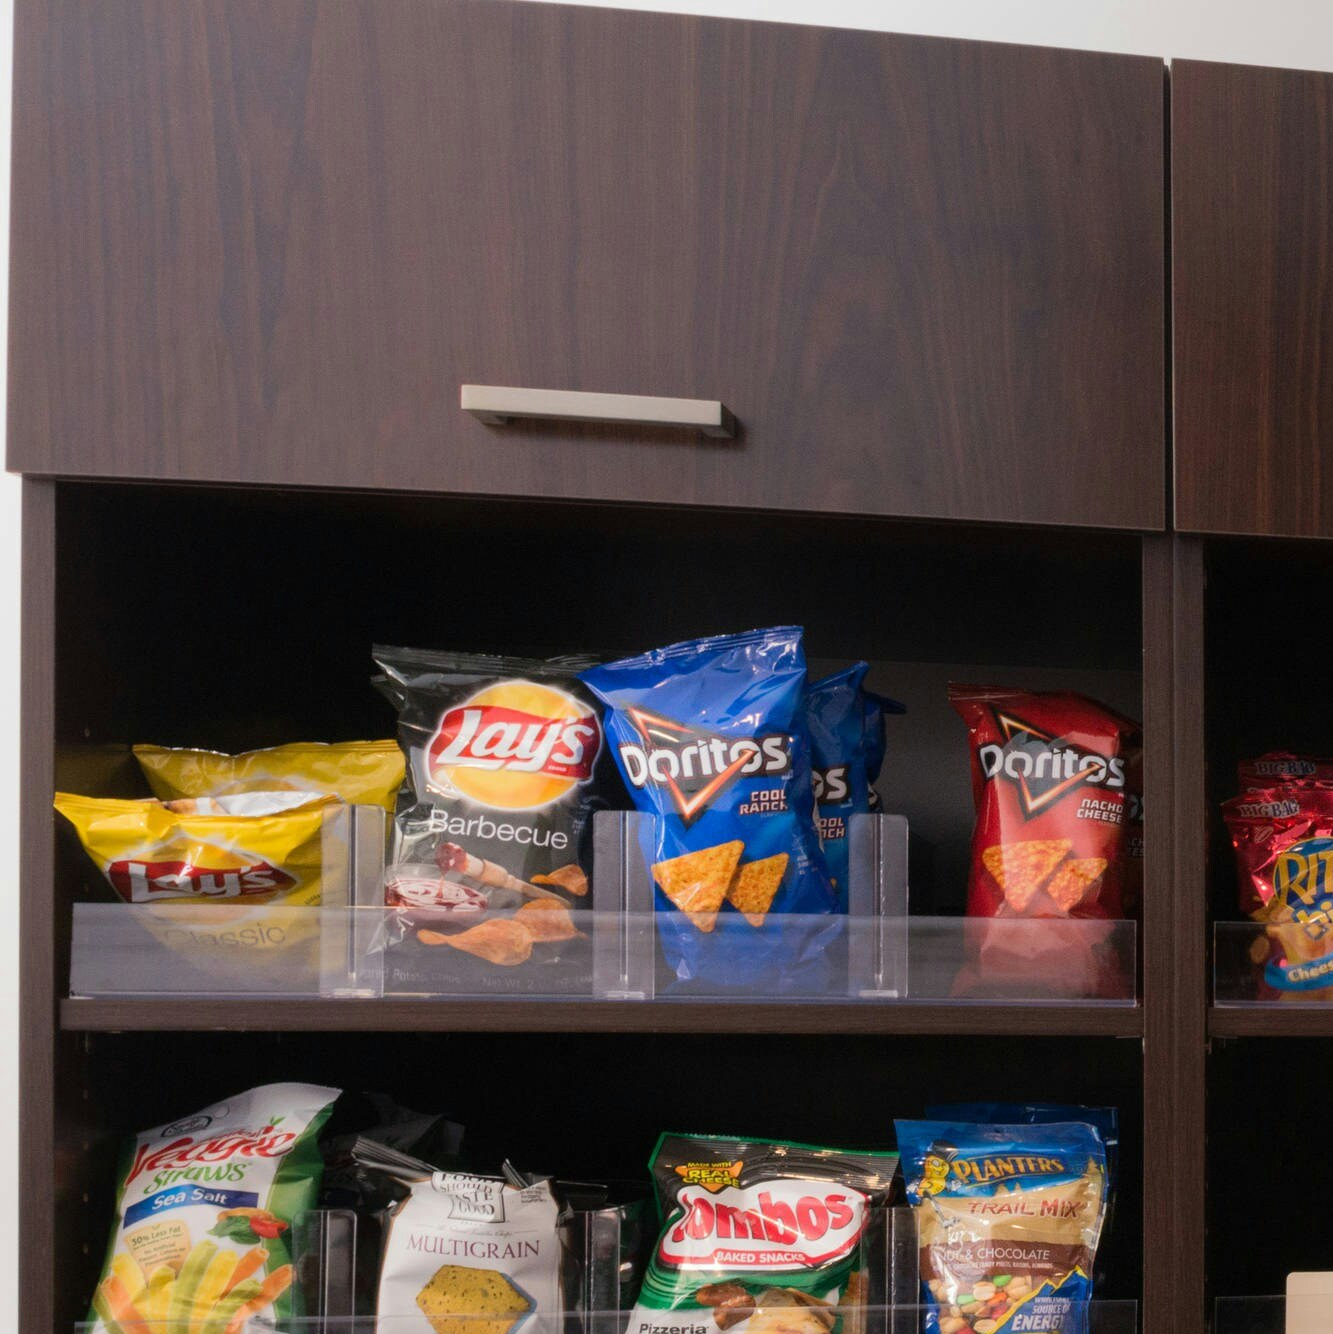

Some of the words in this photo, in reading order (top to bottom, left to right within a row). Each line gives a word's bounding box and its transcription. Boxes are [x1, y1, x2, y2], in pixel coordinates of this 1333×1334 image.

[437, 709, 595, 770] Lay's
[619, 735, 790, 789] Doritos
[980, 744, 1125, 788] Doritos
[750, 789, 787, 803] COOL
[1081, 799, 1124, 814] NACHO
[739, 800, 789, 816] RANCH
[1076, 809, 1123, 824] CHEESE
[429, 809, 568, 850] Barbecue
[124, 860, 281, 903] Lay's
[125, 1126, 296, 1187] Veggie
[688, 1168, 730, 1182] REAL
[953, 1155, 1065, 1188] PLANTERS
[152, 1192, 185, 1210] Sea
[191, 1188, 228, 1204] Salt
[966, 1199, 1037, 1218] TRAIL
[1040, 1199, 1082, 1219] MIX
[406, 1234, 540, 1259] MULTIGRAIN
[715, 1250, 757, 1263] BAKED
[760, 1250, 805, 1264] SNACKS
[976, 1247, 1051, 1260] CHOCOLATE
